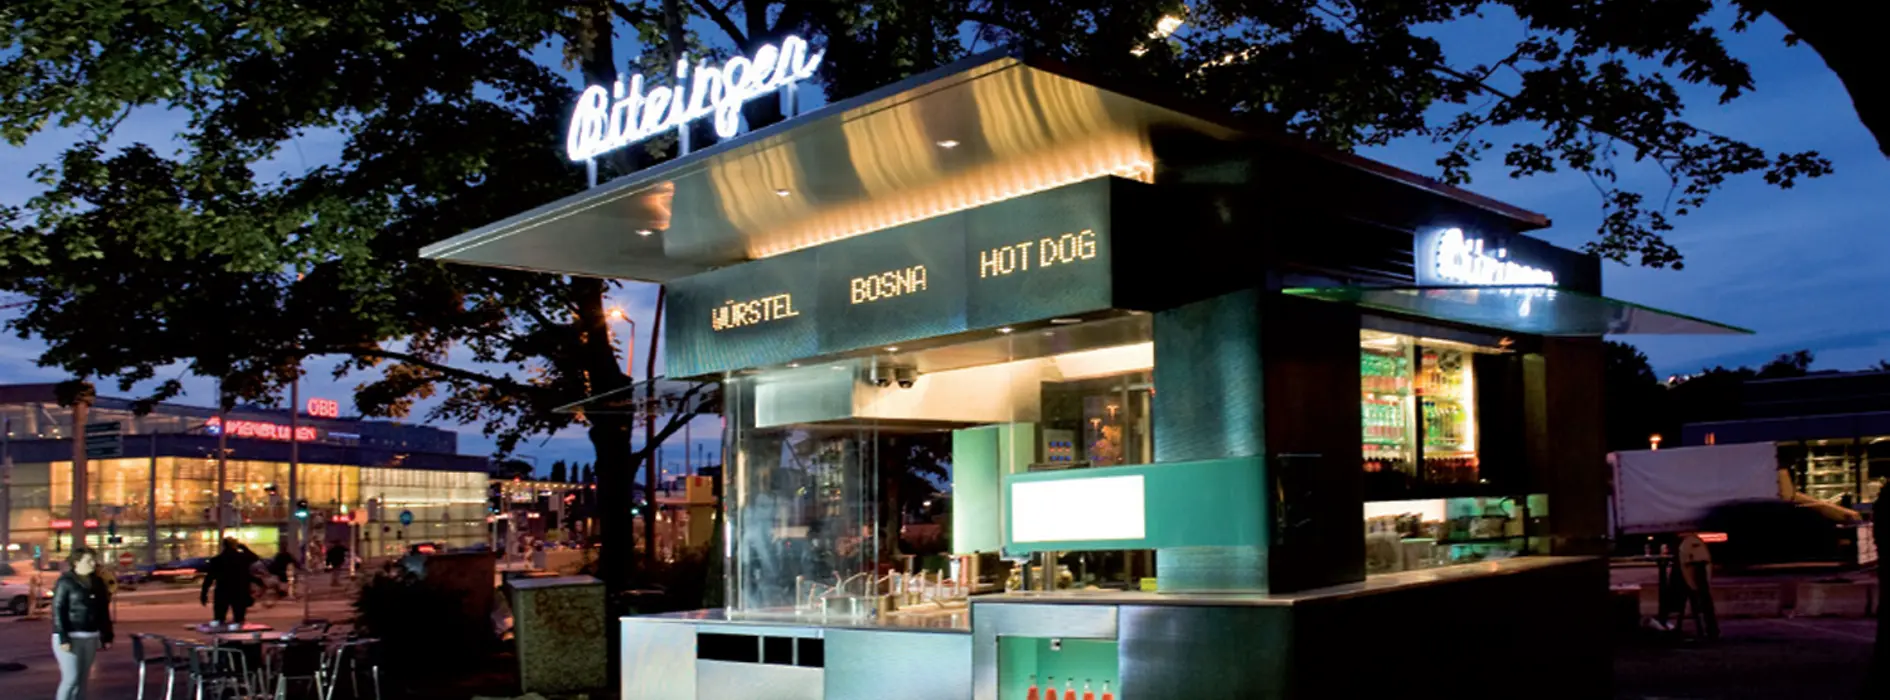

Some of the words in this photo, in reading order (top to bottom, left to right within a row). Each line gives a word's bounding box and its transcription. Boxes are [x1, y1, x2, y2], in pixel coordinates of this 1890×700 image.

[711, 293, 799, 332] WÜRSTEL
[850, 265, 927, 305] BOSNA
[980, 241, 1033, 278] HOT
[1040, 229, 1096, 267] DOG
